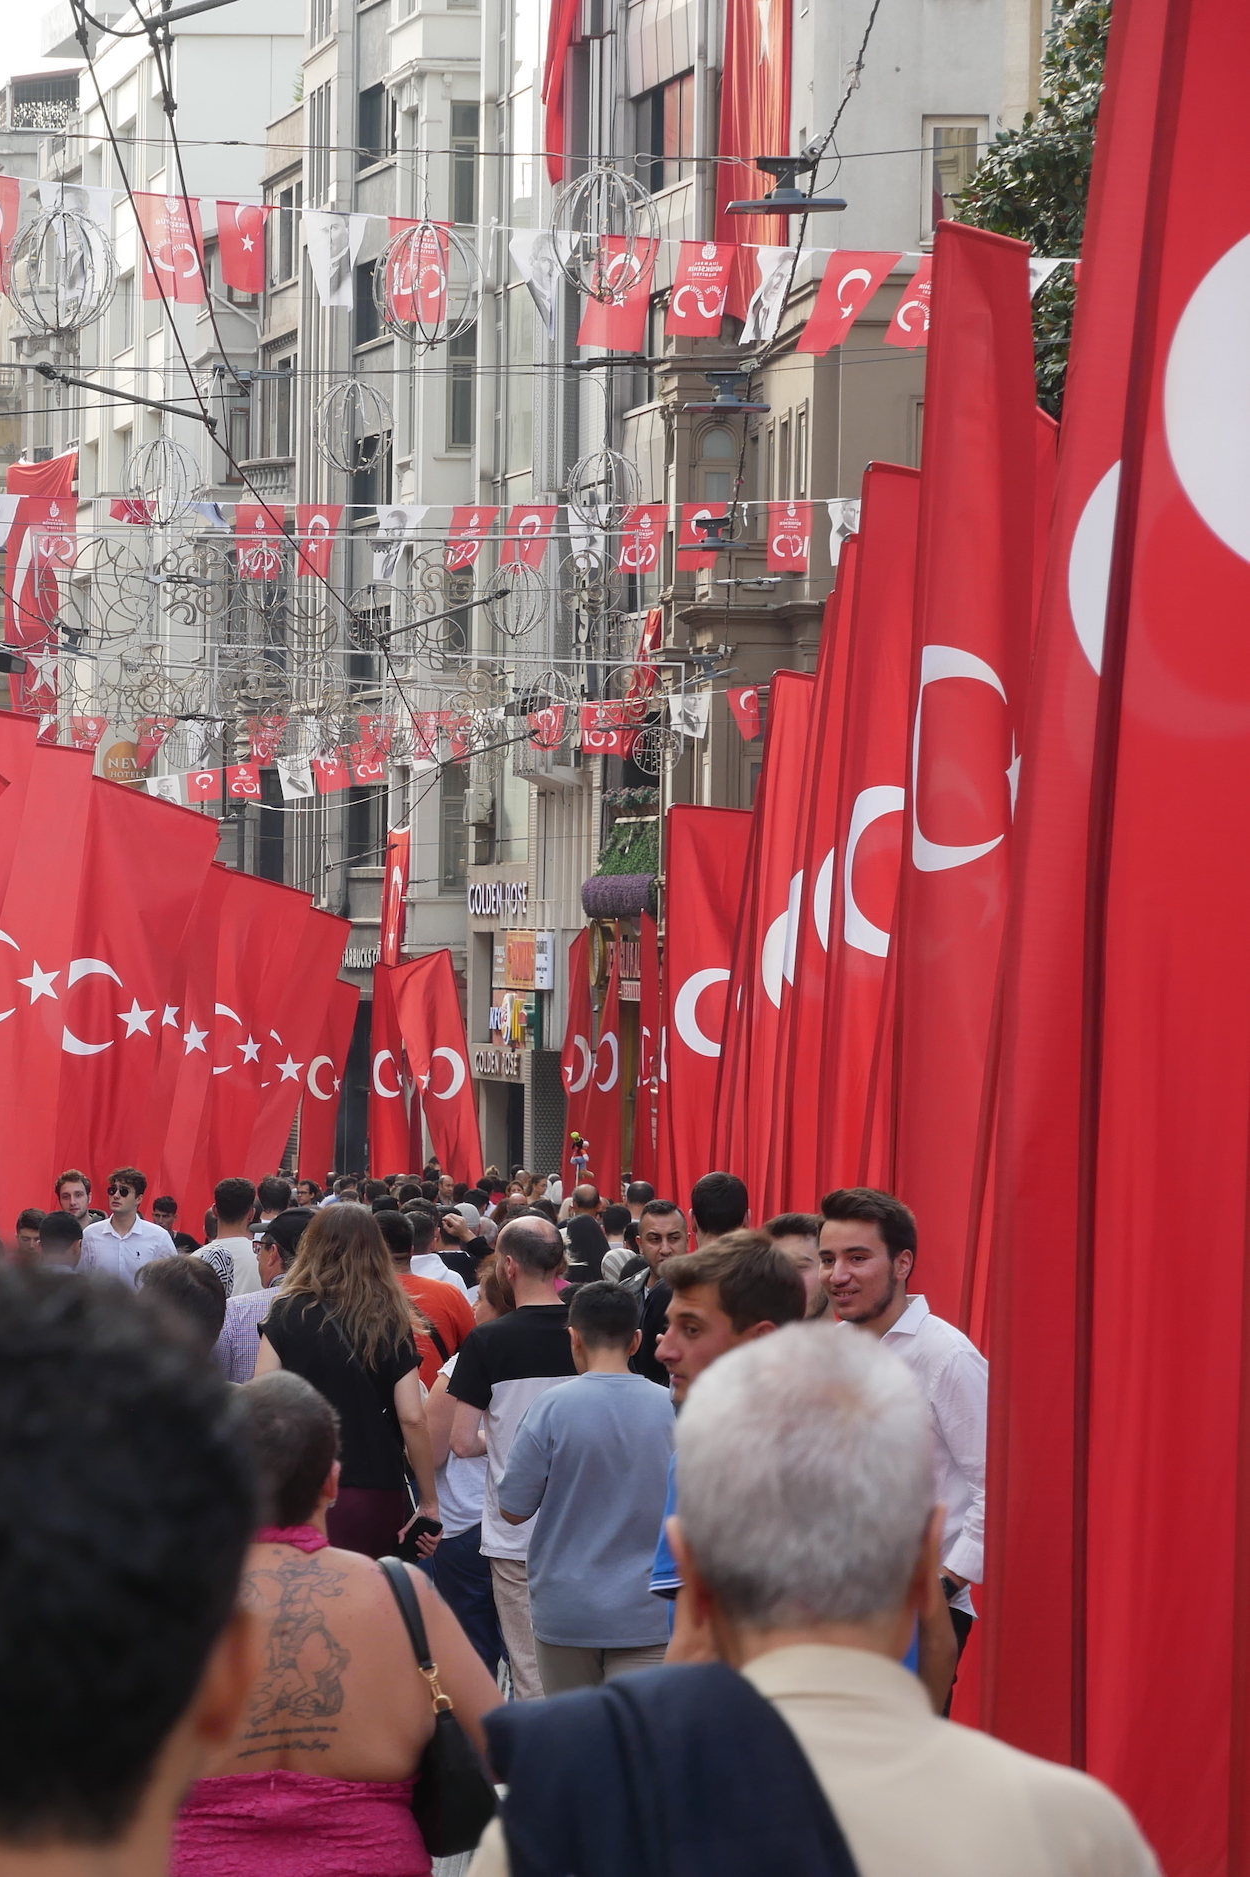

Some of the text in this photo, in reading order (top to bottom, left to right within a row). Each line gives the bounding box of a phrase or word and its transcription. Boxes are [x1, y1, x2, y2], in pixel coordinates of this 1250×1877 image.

[108, 757, 147, 769] NEV
[110, 771, 147, 779] HOTELS
[468, 883, 502, 914] GOLDEN
[475, 1051, 499, 1074] GOLDEN
